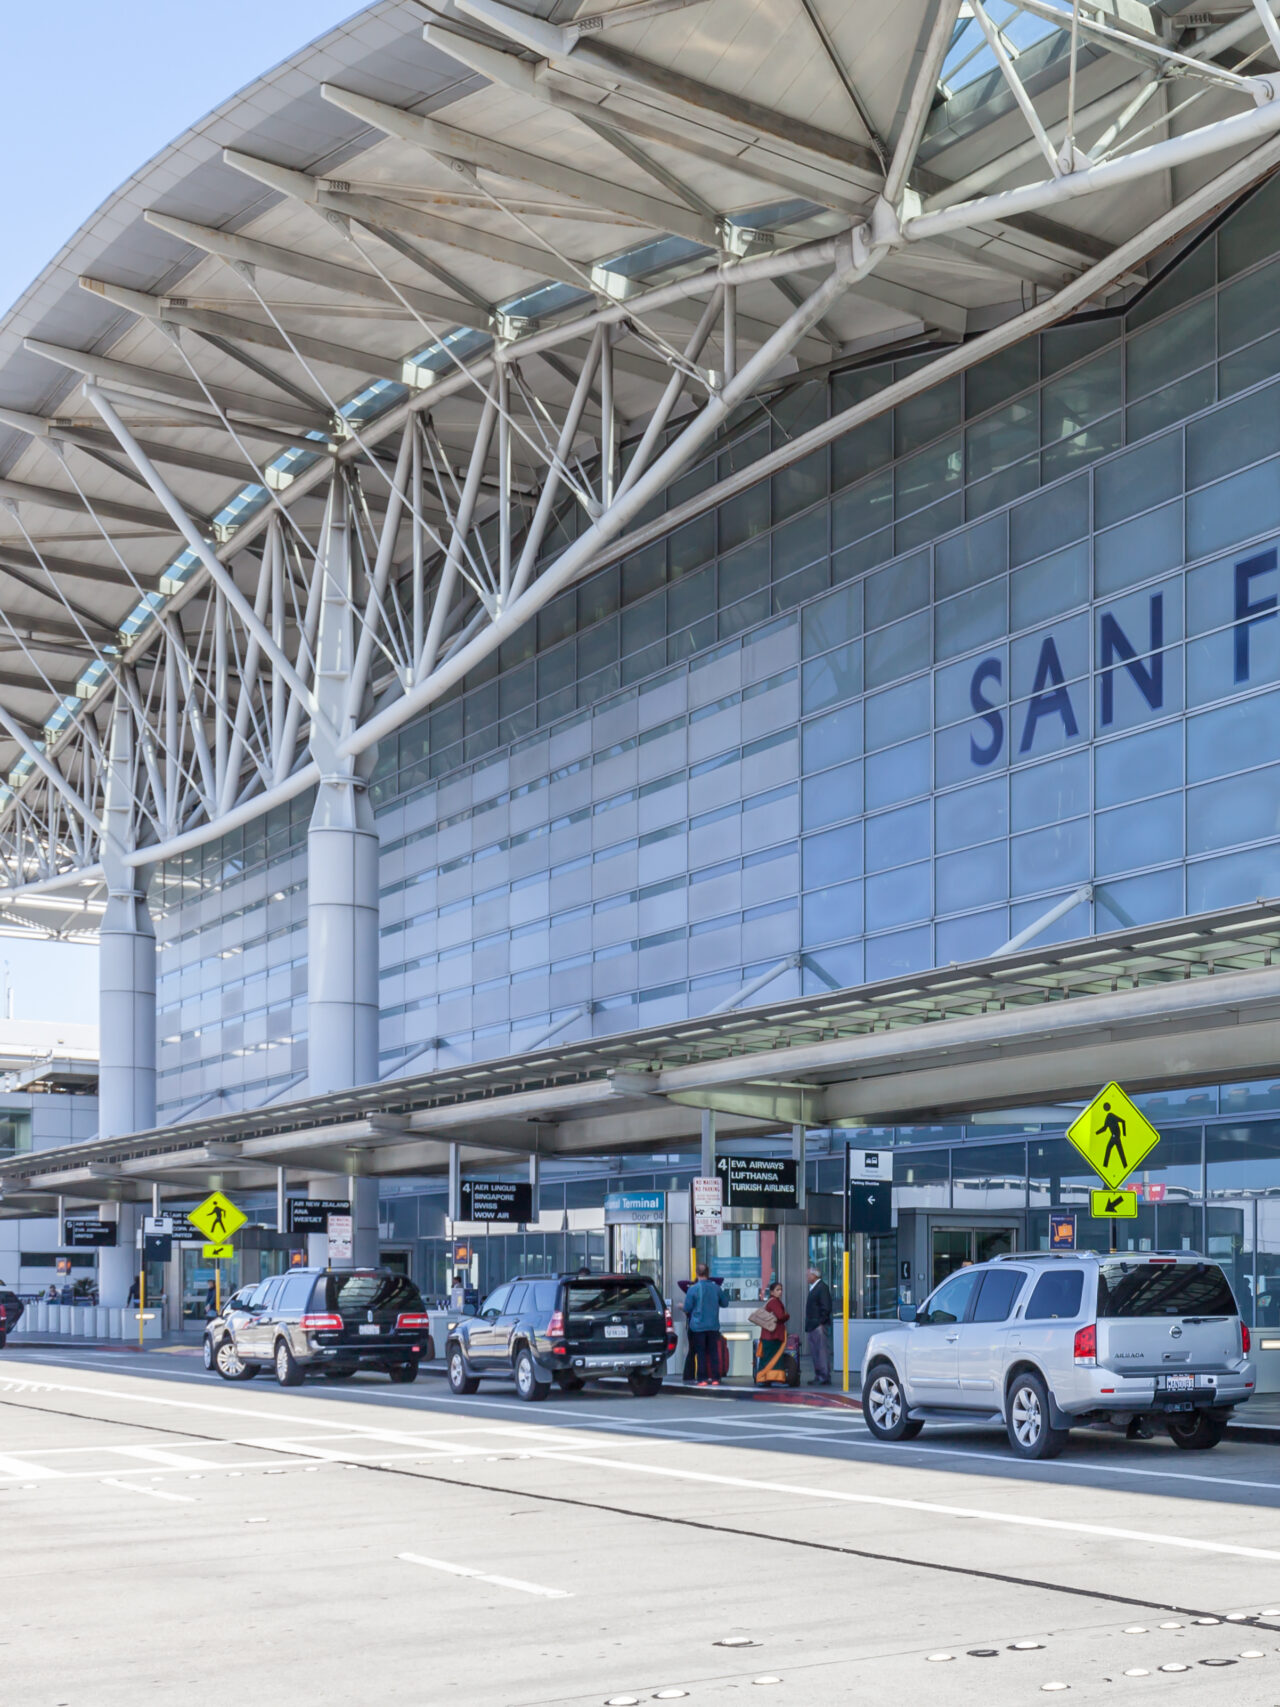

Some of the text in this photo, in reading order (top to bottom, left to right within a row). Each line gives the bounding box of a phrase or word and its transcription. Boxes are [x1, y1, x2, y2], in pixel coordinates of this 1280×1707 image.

[970, 590, 1164, 767] SAN
[718, 1158, 727, 1170] 4
[731, 1160, 784, 1170] EVA AIRWAYS
[731, 1172, 778, 1181] LUFTHANSA
[462, 1183, 471, 1192] 4
[491, 1184, 517, 1192] LINGUS
[731, 1183, 795, 1193] TURKISH AIRLINES
[474, 1193, 515, 1201] SINGAPORE
[622, 1197, 659, 1209] Terminal
[632, 1211, 664, 1221] Door 04
